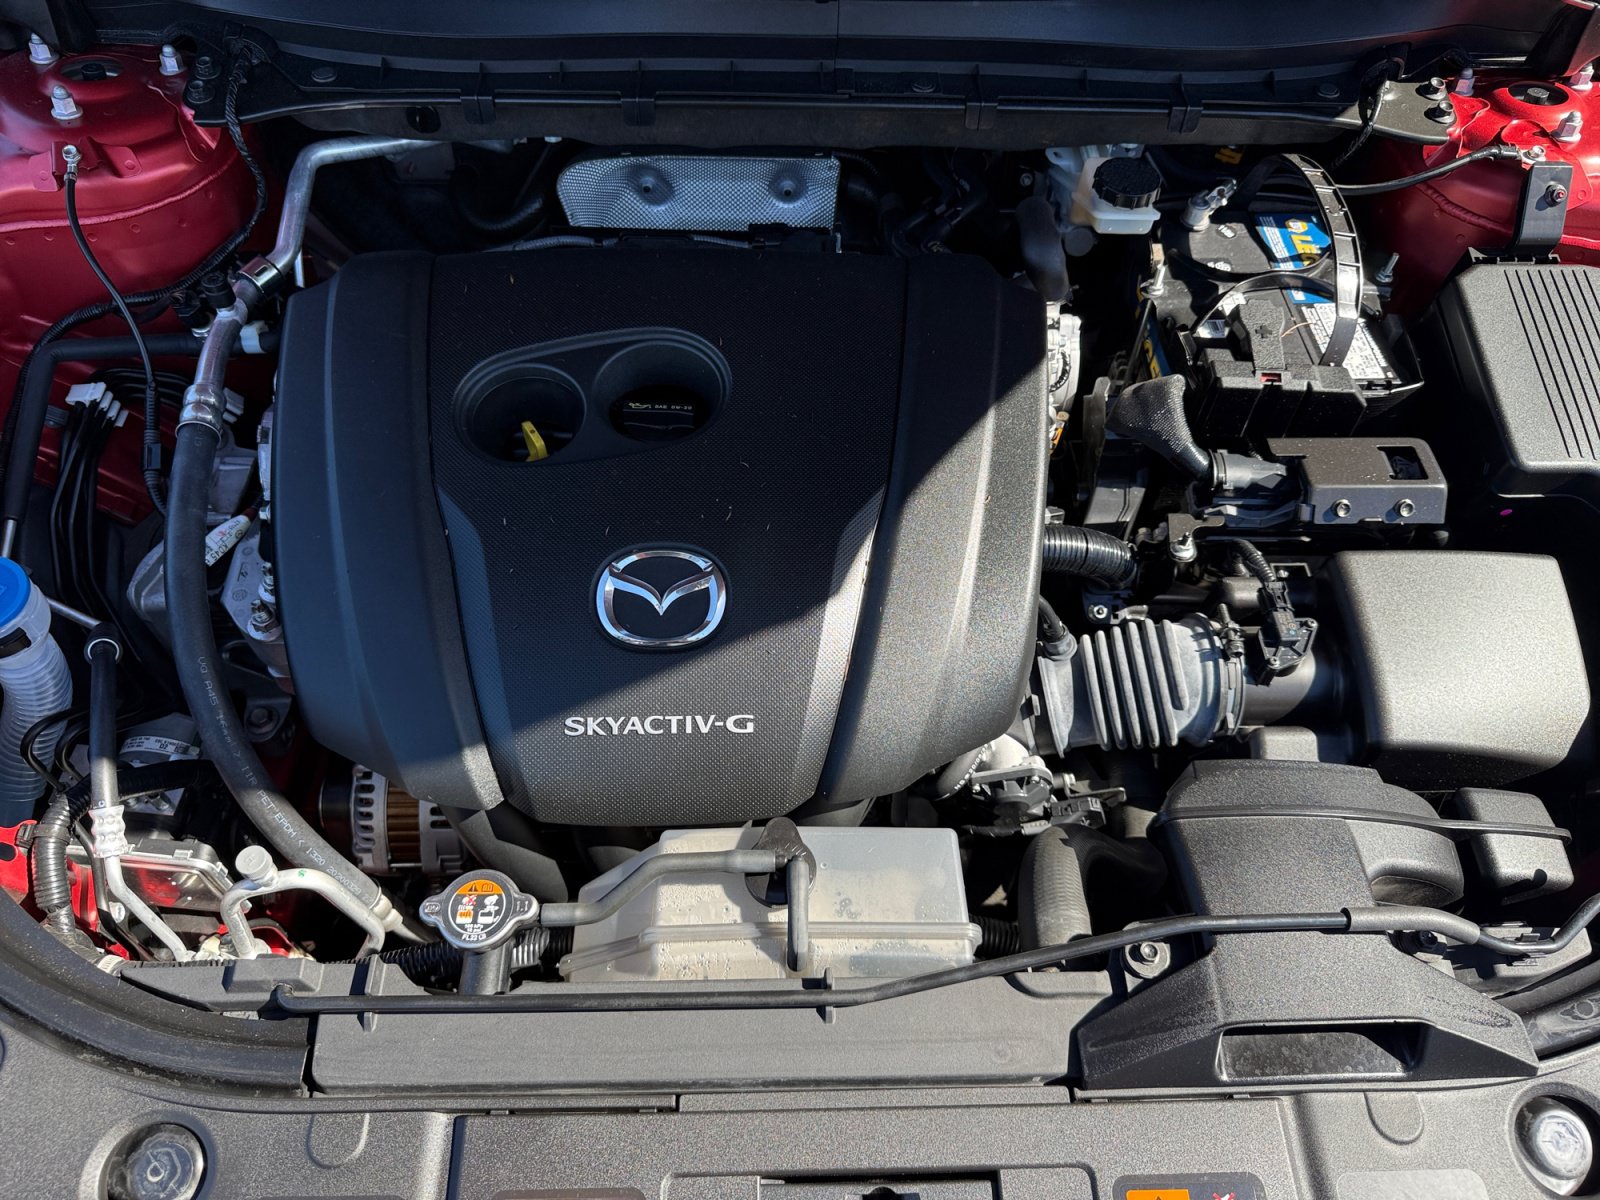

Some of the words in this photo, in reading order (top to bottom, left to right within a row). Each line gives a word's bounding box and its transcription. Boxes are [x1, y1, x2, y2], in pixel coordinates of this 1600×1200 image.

[563, 714, 755, 737] SKYACTIV-G
[274, 812, 297, 838] EPDM
[306, 847, 326, 866] 1320
